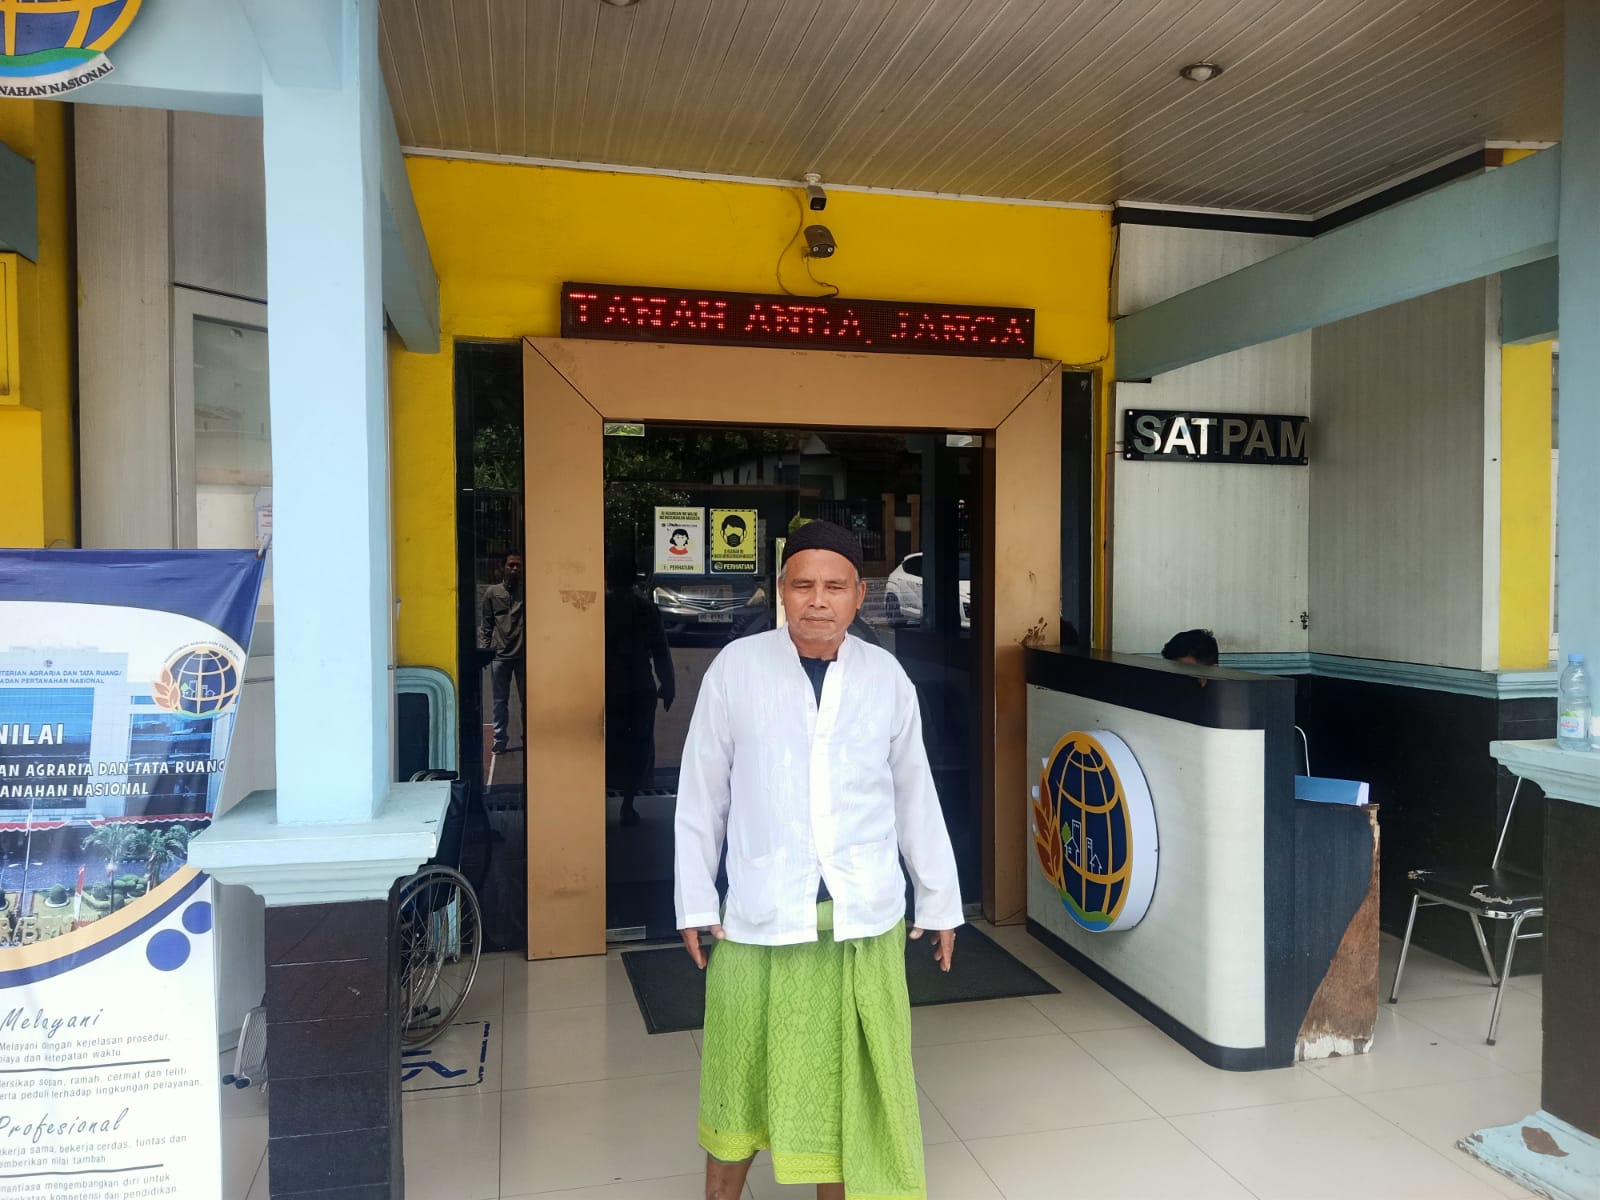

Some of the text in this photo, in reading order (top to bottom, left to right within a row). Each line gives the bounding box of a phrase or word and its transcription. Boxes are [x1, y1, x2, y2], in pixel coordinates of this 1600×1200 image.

[48, 62, 114, 94] NASIONAL
[569, 292, 728, 329] TANAH
[1133, 415, 1310, 458] SATPAM
[0, 724, 64, 745] NILAI
[0, 764, 20, 777] AN
[25, 762, 94, 777] AGRARIA
[98, 760, 129, 776] DAN
[134, 760, 169, 775] TATA
[0, 782, 149, 798] ANAHAN NASIONAL
[0, 1007, 104, 1039] Melayani
[0, 1041, 38, 1052] Melayani
[76, 1036, 124, 1048] kejelasan
[24, 1054, 41, 1063] dan
[92, 1049, 121, 1058] waktu
[107, 1071, 140, 1082] cermat
[144, 1068, 162, 1079] dan
[165, 1066, 187, 1077] teliti
[21, 1087, 49, 1100] peduli
[51, 1086, 92, 1099] terhadap
[96, 1081, 149, 1095] lingkungan
[0, 1107, 130, 1143] Profesional
[59, 1143, 94, 1154] bekerja
[136, 1137, 166, 1147] tuntas
[169, 1134, 187, 1144] dan
[51, 1155, 69, 1165] nilai
[72, 1154, 106, 1165] tambah
[45, 1177, 119, 1191] mengembangkan
[123, 1177, 139, 1187] diri
[143, 1173, 171, 1184] untuk
[105, 1189, 119, 1199] dan
[123, 1184, 177, 1200] pendidikan
